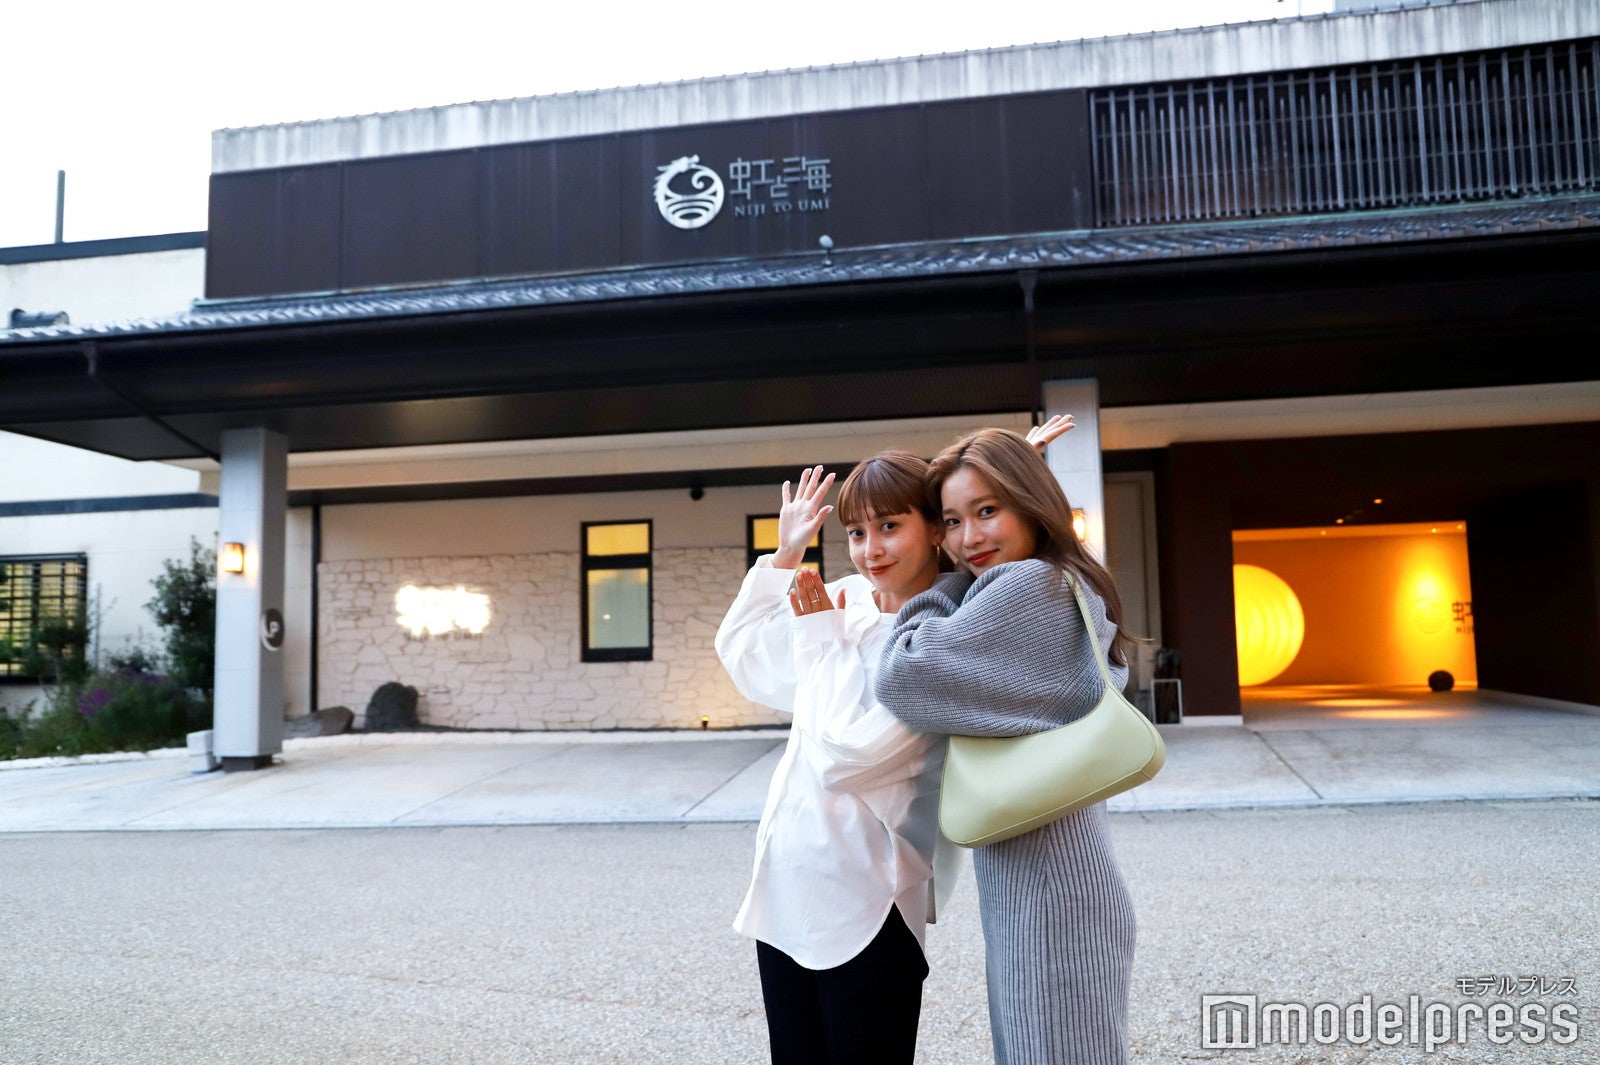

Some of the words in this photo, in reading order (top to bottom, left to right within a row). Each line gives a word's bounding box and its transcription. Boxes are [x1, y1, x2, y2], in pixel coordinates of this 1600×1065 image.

[729, 156, 832, 199] 虹と海
[734, 204, 766, 217] NIJI
[773, 201, 793, 213] TO
[799, 198, 831, 211] UMI
